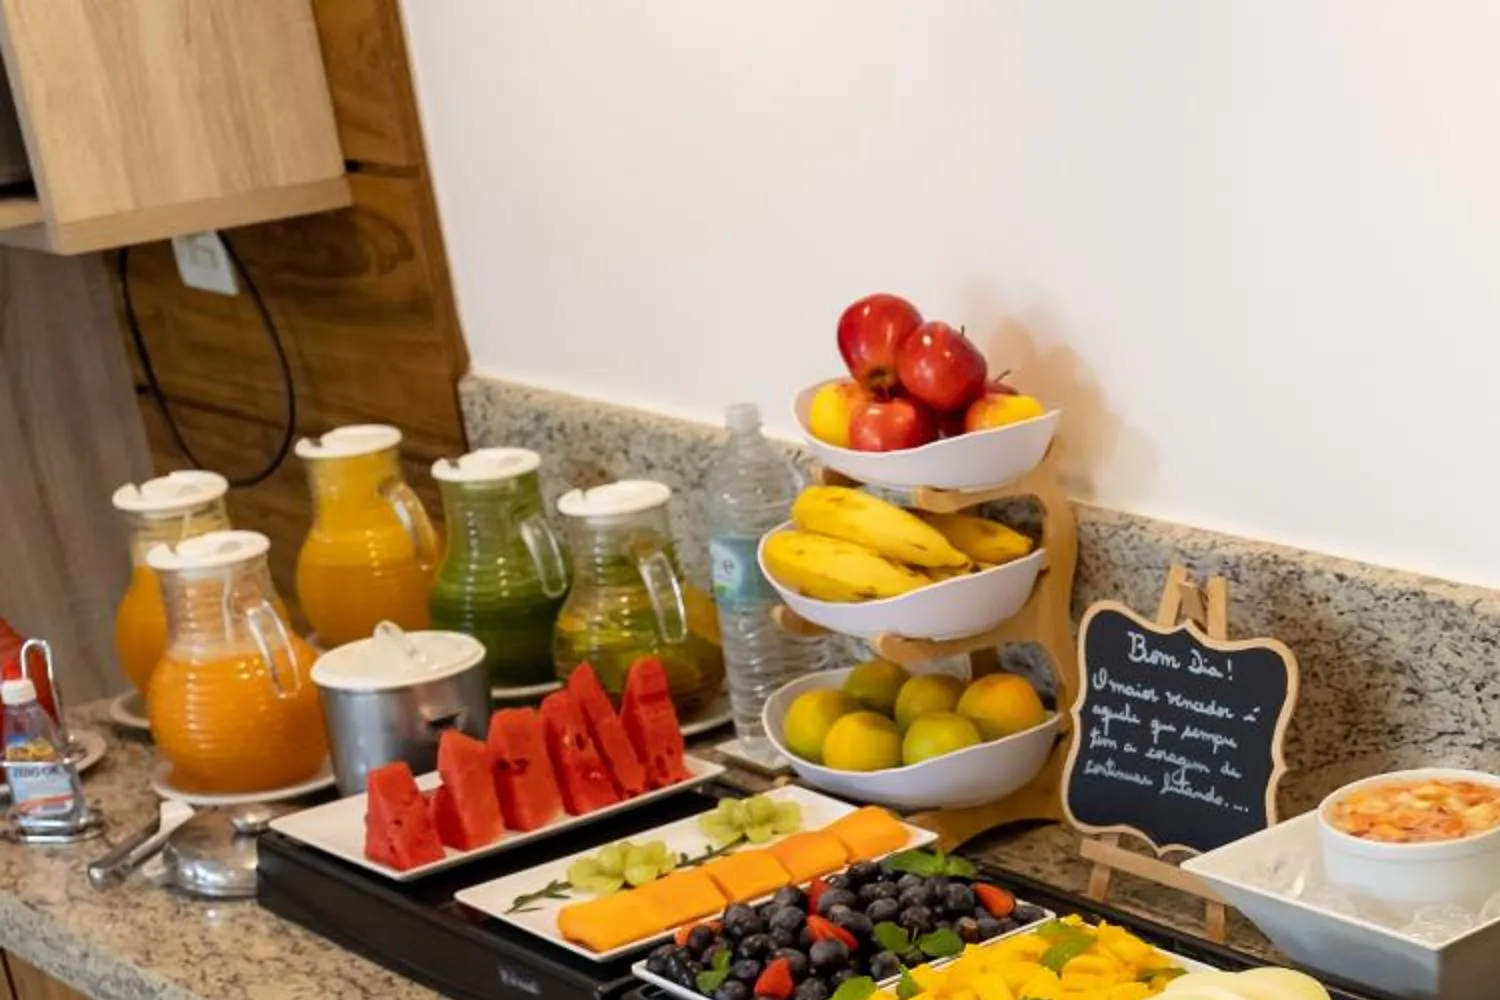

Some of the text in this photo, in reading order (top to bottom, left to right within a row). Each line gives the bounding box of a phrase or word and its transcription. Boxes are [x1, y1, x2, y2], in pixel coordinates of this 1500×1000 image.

[1127, 631, 1233, 681] Bom Dia!
[1092, 667, 1261, 722] O maior vencedor é
[1091, 703, 1238, 755] aquele que sempre
[1089, 726, 1243, 786] tem a coragem de
